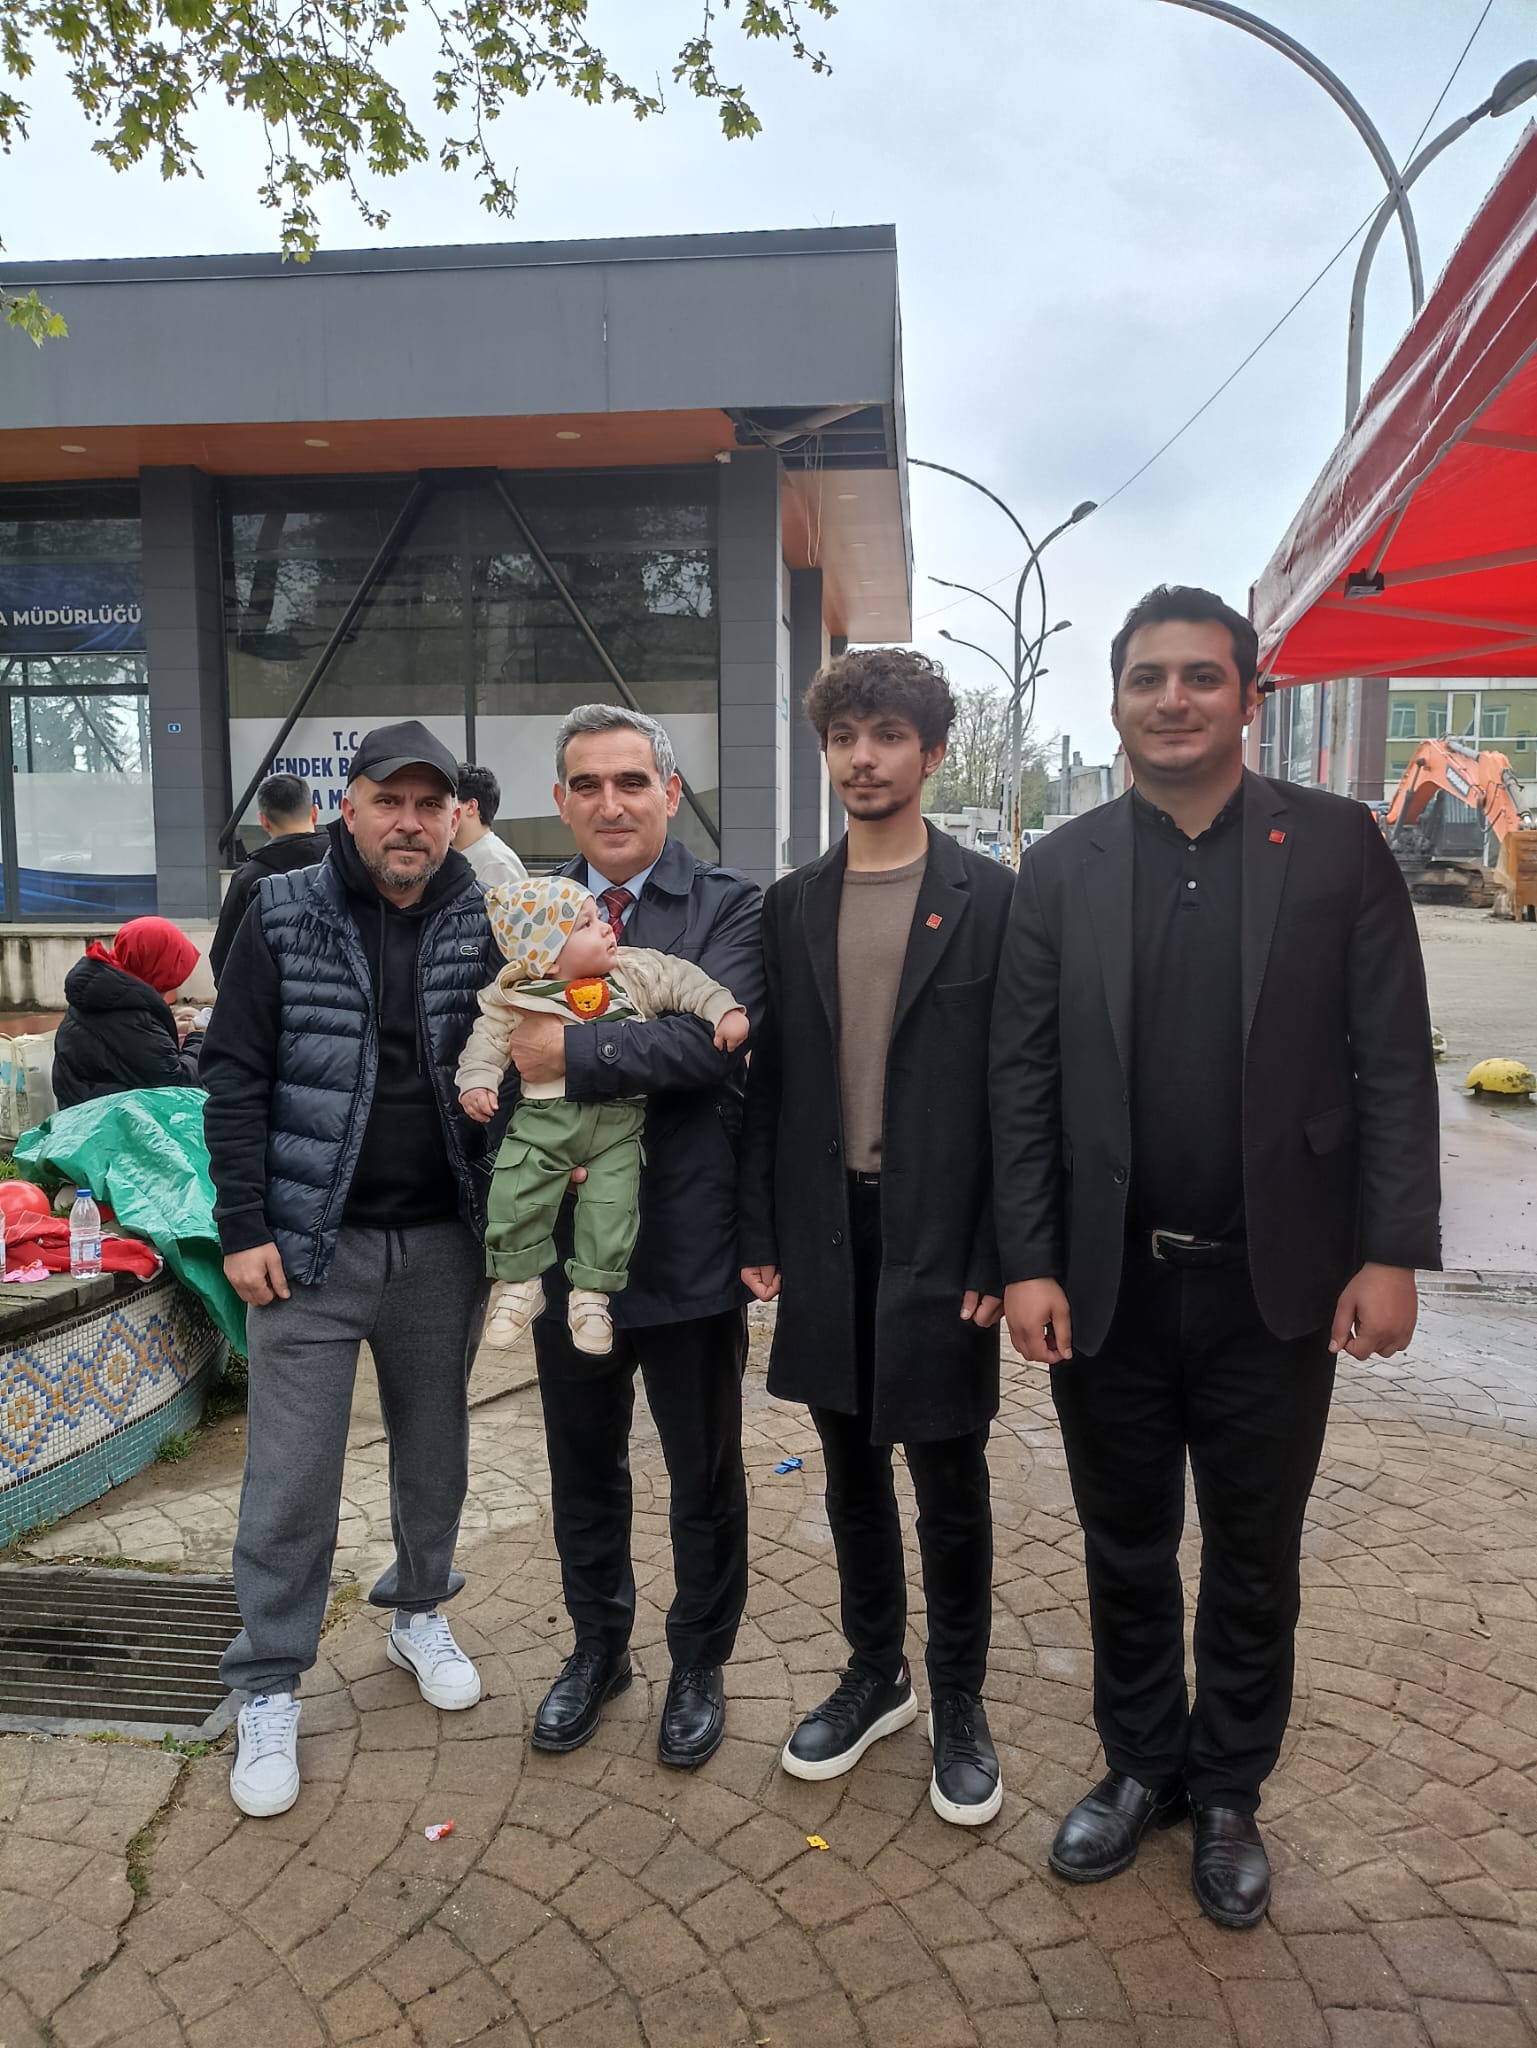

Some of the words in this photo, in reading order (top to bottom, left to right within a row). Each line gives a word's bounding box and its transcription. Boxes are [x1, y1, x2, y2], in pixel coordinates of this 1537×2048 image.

[13, 604, 142, 626] MÜDÜRLÜĞÜ
[339, 757, 353, 777] B
[328, 789, 346, 810] M
